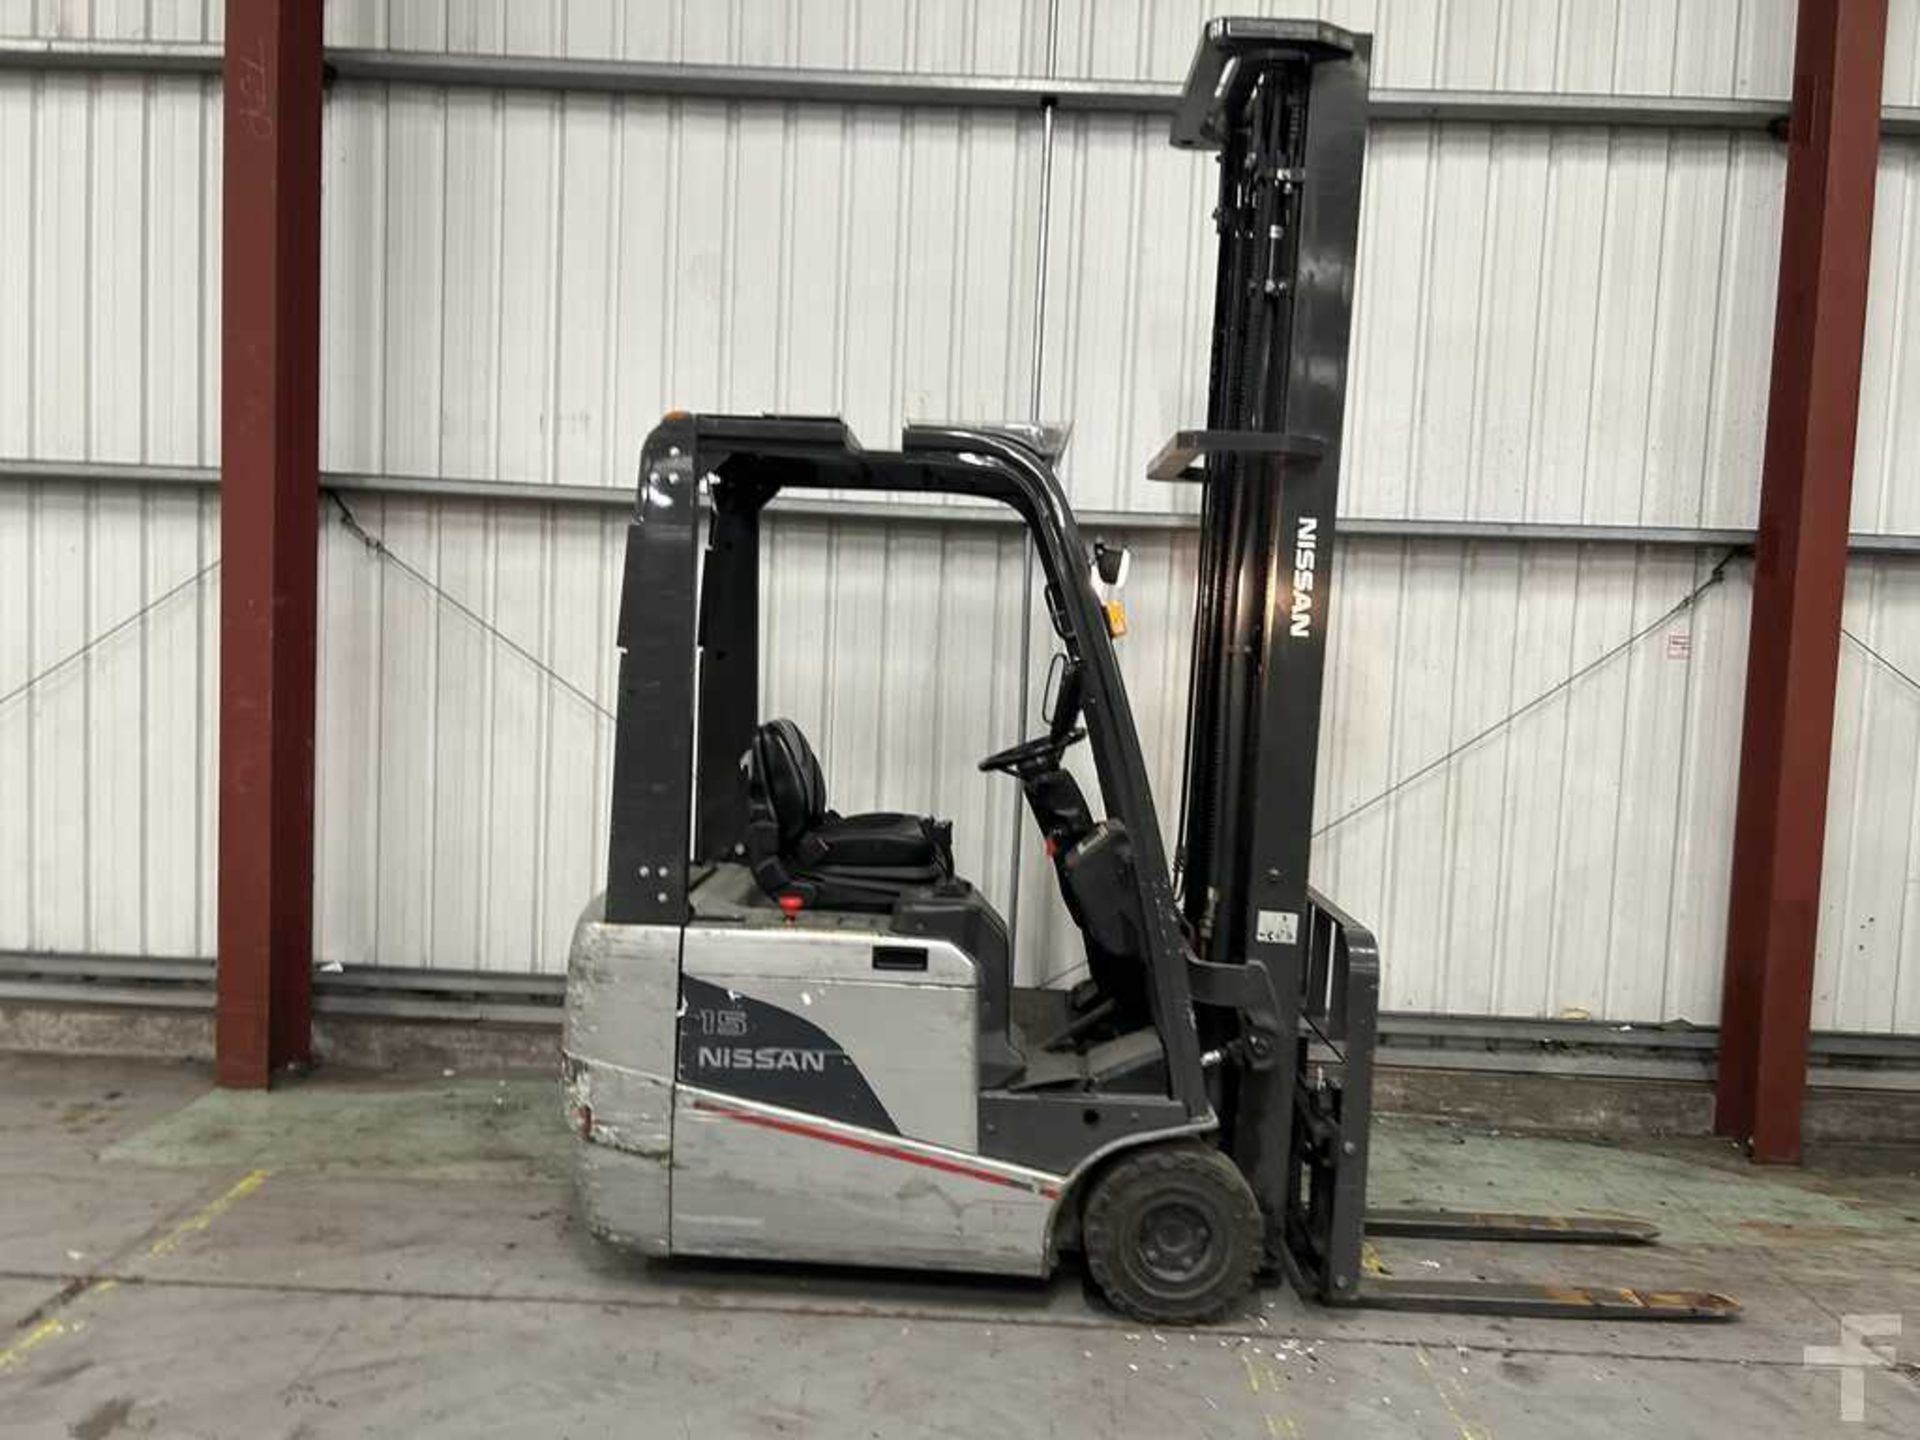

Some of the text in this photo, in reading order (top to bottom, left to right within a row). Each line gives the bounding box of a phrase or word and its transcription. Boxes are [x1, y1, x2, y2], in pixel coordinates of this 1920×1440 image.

[1290, 517, 1318, 637] NISSAN
[701, 1009, 747, 1035] 15
[699, 1047, 825, 1072] NISSAN
